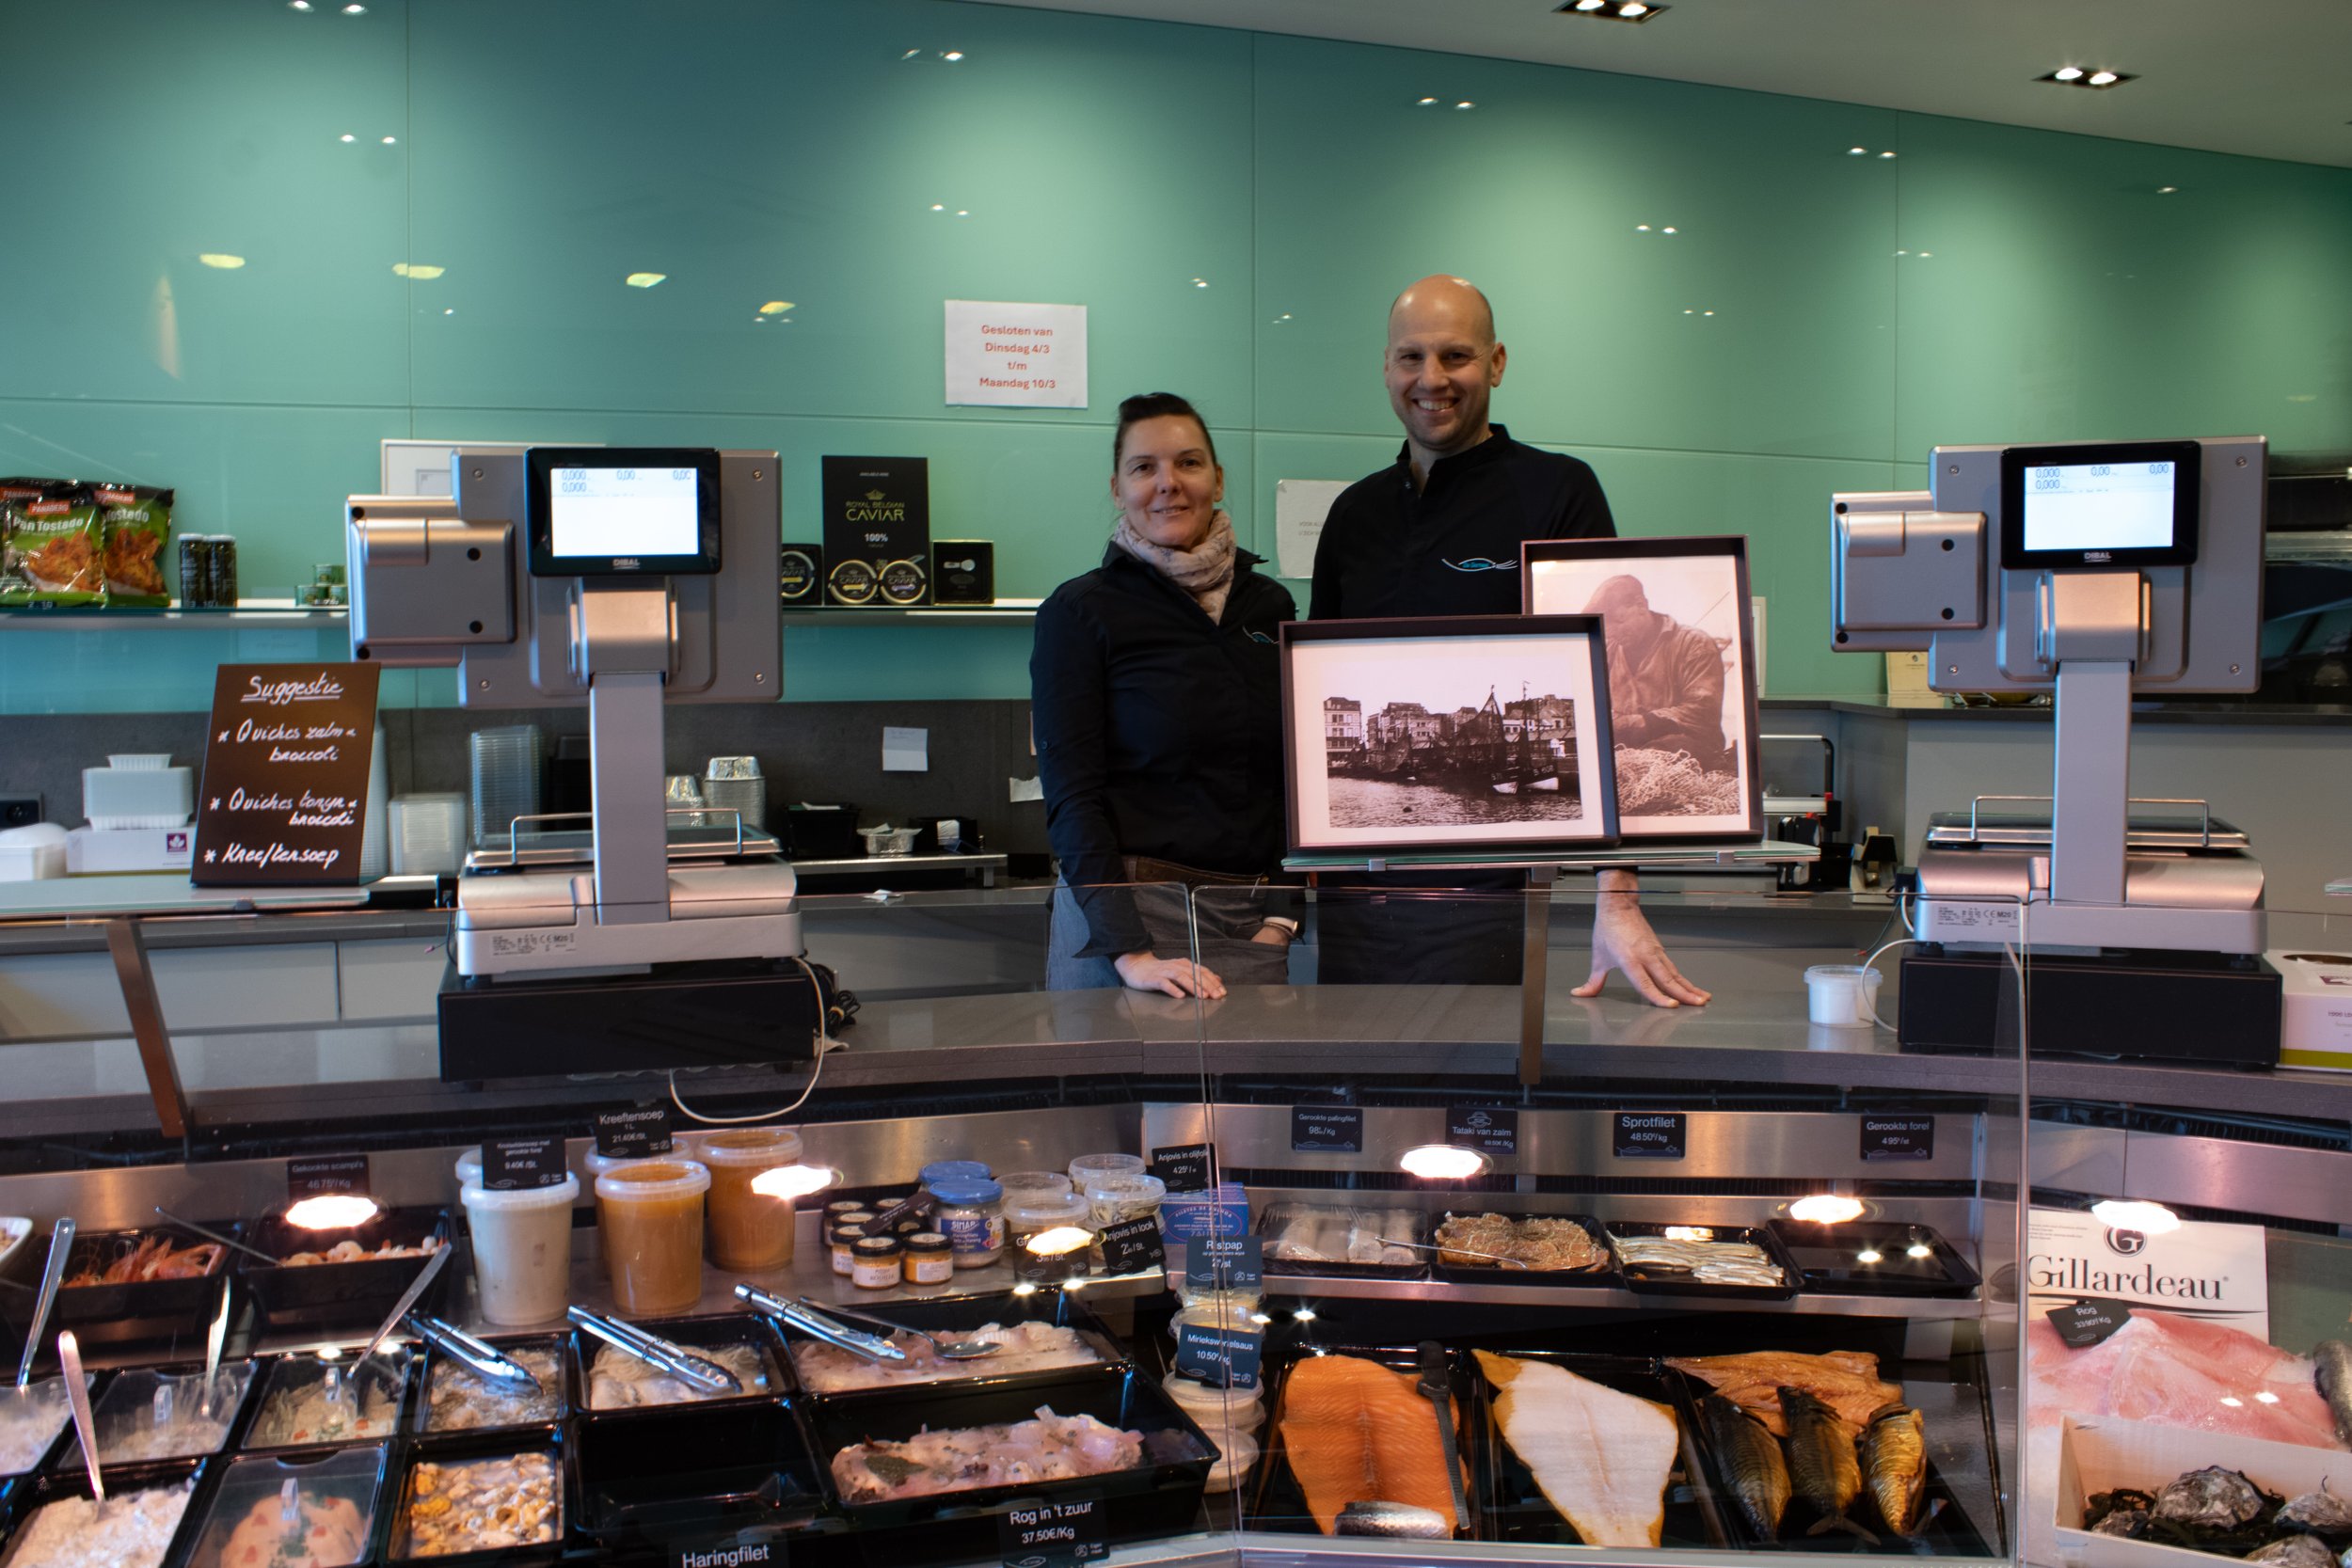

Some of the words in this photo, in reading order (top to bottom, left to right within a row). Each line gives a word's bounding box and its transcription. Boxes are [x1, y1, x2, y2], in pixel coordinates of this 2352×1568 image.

[981, 325, 1031, 336] Gesloten
[1033, 328, 1053, 337] van
[985, 342, 1030, 356] Dinsdag
[1032, 344, 1050, 354] 4/3
[1008, 361, 1027, 371] t/m
[979, 377, 1030, 389] Maandag
[1032, 379, 1056, 389] 10/3
[846, 509, 905, 522] CAVIAR
[13, 516, 35, 531] Pan
[38, 518, 84, 531] Tostado
[864, 533, 889, 543] 100%
[248, 672, 344, 705] Suggestie
[268, 745, 339, 762] broccoli
[288, 810, 355, 827] broccoli
[598, 1110, 664, 1126] Kreeftensoep
[1622, 1116, 1676, 1130] Sprotfilet
[1453, 1126, 1475, 1135] Tataki
[1476, 1128, 1491, 1136] van
[1492, 1129, 1512, 1137] zalm
[1867, 1121, 1907, 1131] Gerookte
[1909, 1121, 1930, 1131] forel
[1158, 1151, 1182, 1164] Anjovis
[1104, 1227, 1129, 1243] Anjovis
[1130, 1226, 1138, 1235] in
[1138, 1220, 1155, 1232] look
[1206, 1240, 1243, 1251] Rstpap
[2028, 1254, 2225, 1301] Gillardeau
[2075, 1306, 2097, 1316] Rog
[1009, 1511, 1037, 1525] Rog
[1040, 1507, 1052, 1520] in
[1054, 1504, 1063, 1517] 't
[1065, 1501, 1093, 1517] zuur
[682, 1544, 770, 1568] Haringfilet
